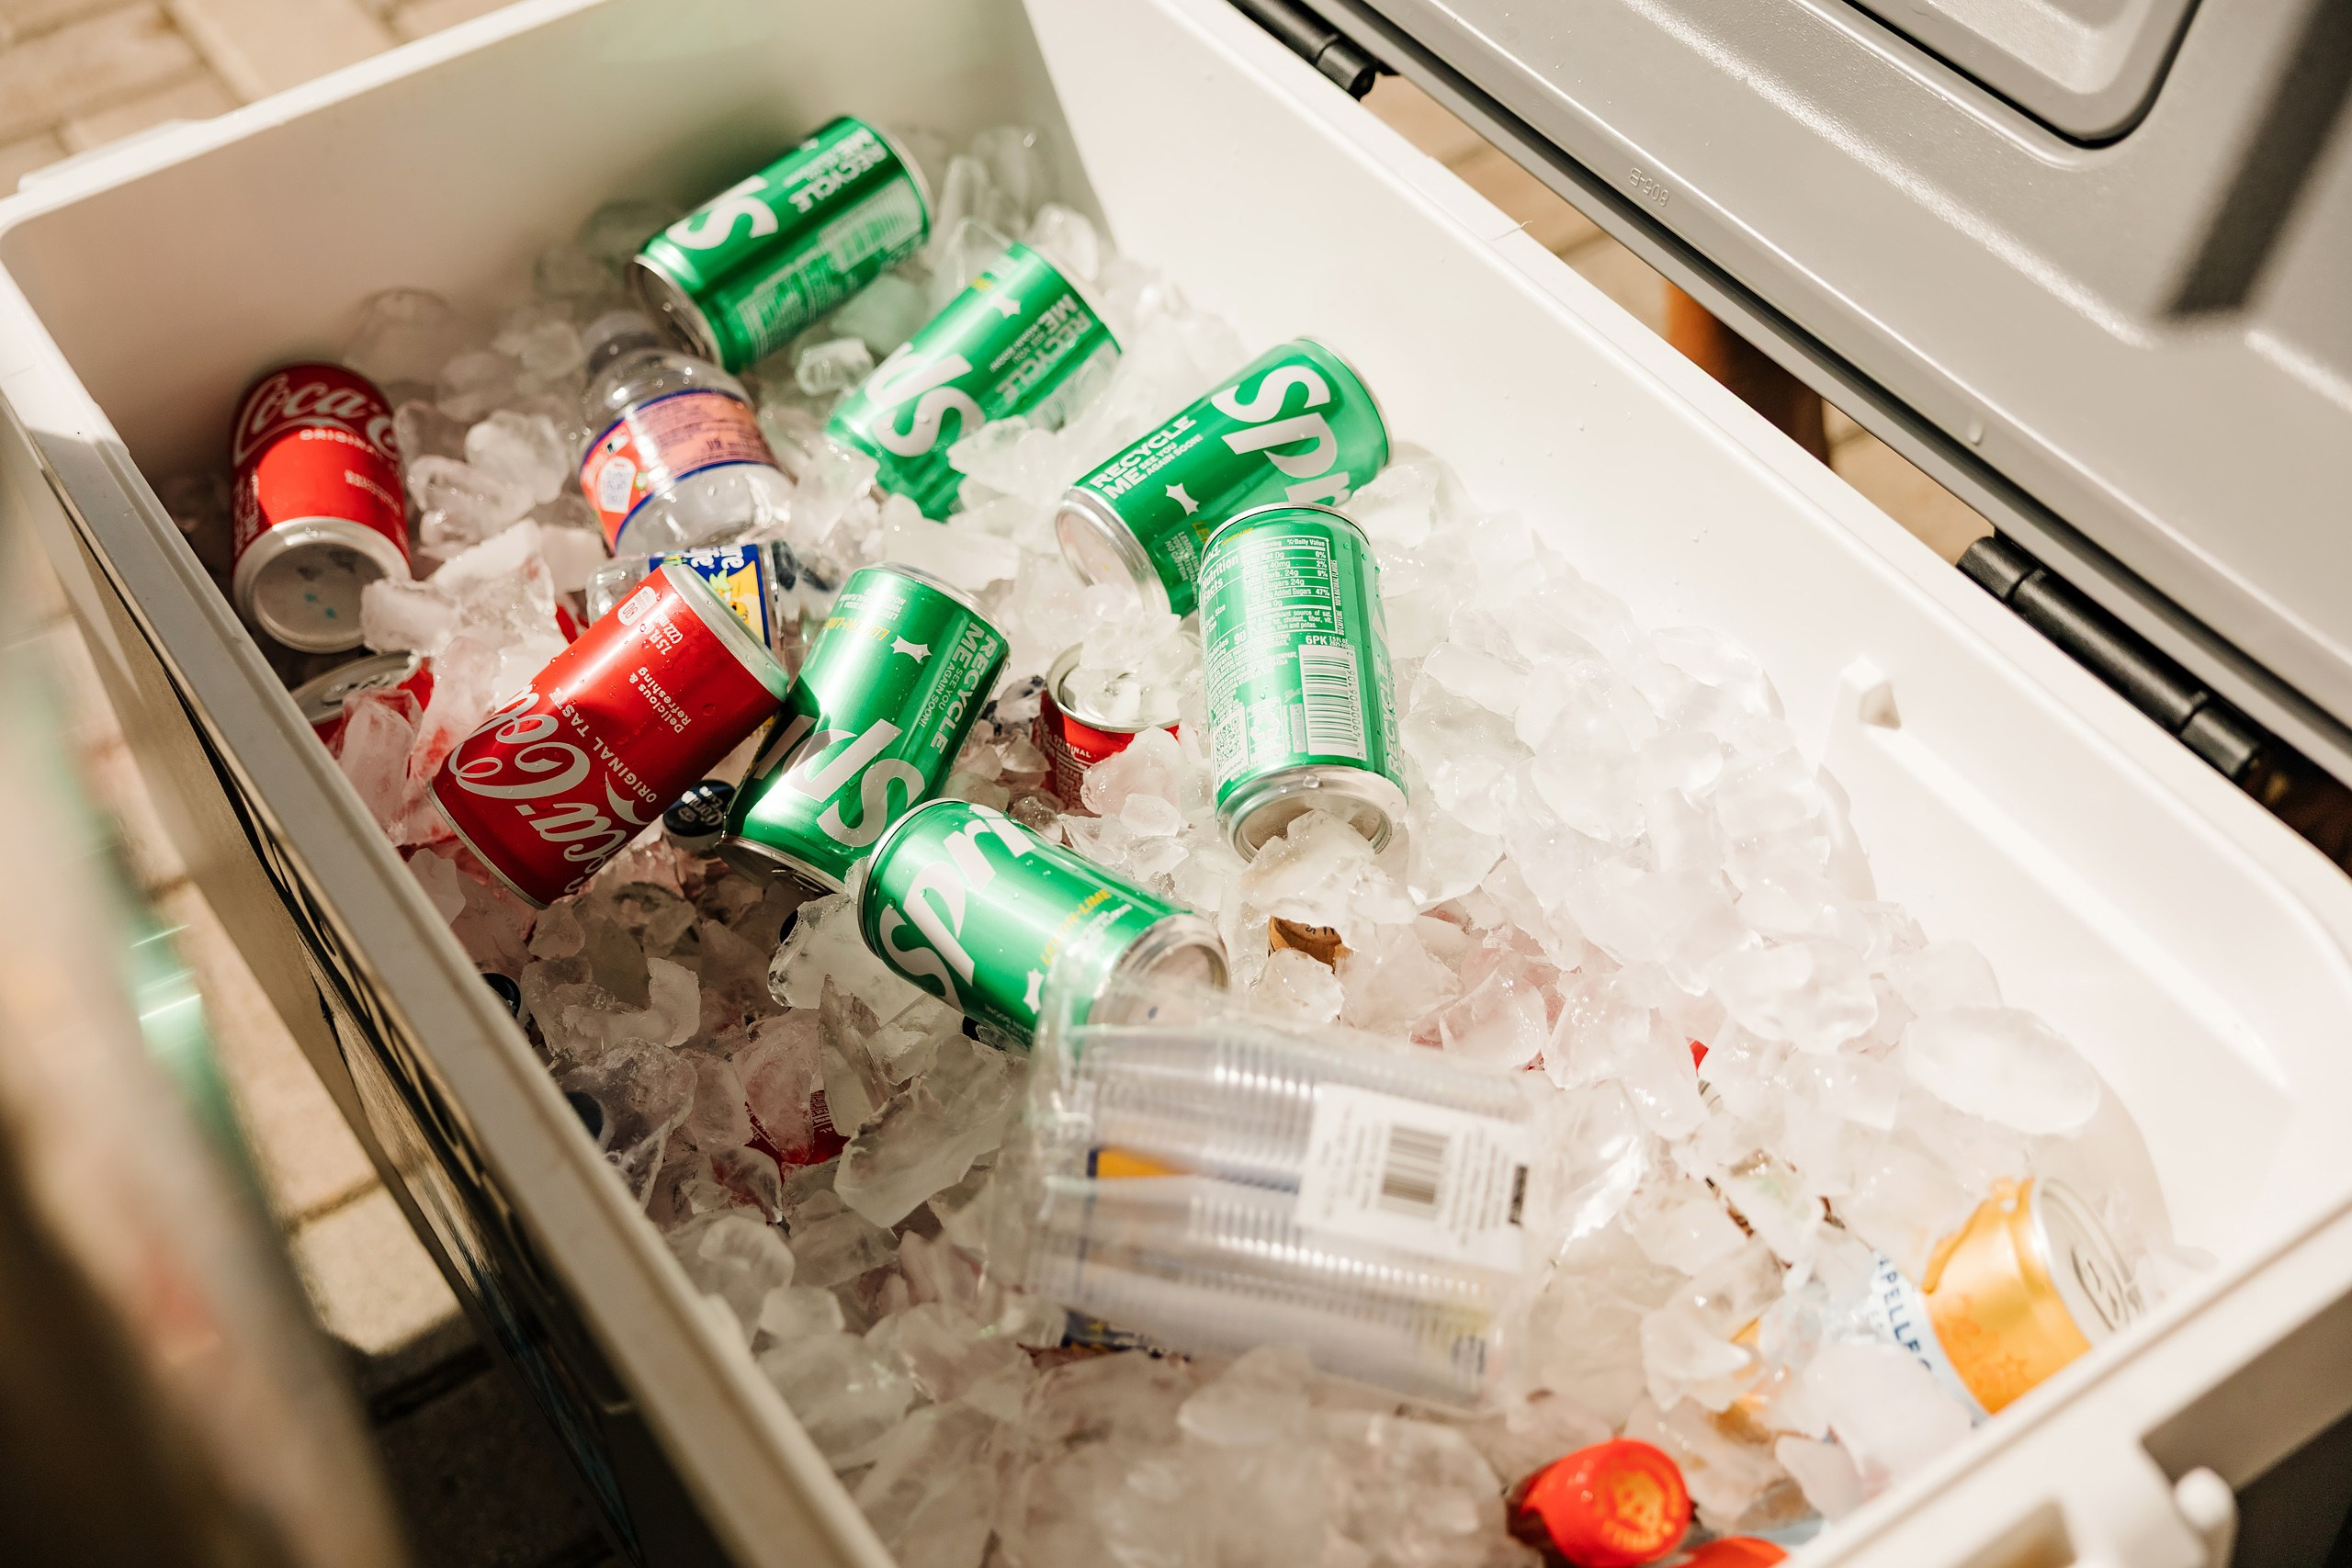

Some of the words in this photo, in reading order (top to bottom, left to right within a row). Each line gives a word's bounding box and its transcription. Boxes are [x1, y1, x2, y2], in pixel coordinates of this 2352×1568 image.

[1035, 292, 1079, 335] ME
[993, 309, 1092, 405] RECYCLE
[1088, 414, 1197, 489] RECYCLE
[1137, 454, 1159, 470] SEE
[1157, 440, 1178, 457] YOU
[1145, 452, 1176, 476] AGAIN
[1101, 466, 1148, 500] ME
[1164, 539, 1175, 552] NO
[1308, 538, 1325, 547] Value
[1203, 554, 1238, 589] Nutrition
[1269, 559, 1291, 569] 40mg
[1316, 559, 1327, 568] 2%
[1283, 569, 1298, 577] 24g
[1202, 577, 1224, 604] Facts
[1263, 578, 1289, 589] Sugars
[1290, 578, 1305, 586] 24g
[1273, 588, 1291, 597] Added
[1292, 588, 1311, 596] Sugars
[1315, 588, 1330, 596] 47%
[951, 621, 984, 669] ME
[1232, 629, 1248, 645] 90
[1305, 635, 1328, 645] 6PK
[625, 671, 639, 685] &
[934, 660, 956, 695] AGAIN
[948, 667, 963, 688] SEE
[1346, 670, 1357, 701] 06106
[635, 664, 692, 726] Refreshing
[636, 682, 684, 734] Delicious
[929, 634, 999, 754] RECYCLE
[937, 687, 953, 710] YOU
[548, 686, 591, 738] TASTE
[918, 693, 939, 728] SOON!
[1350, 705, 1361, 737] 49000
[589, 735, 658, 805] ORIGINAL
